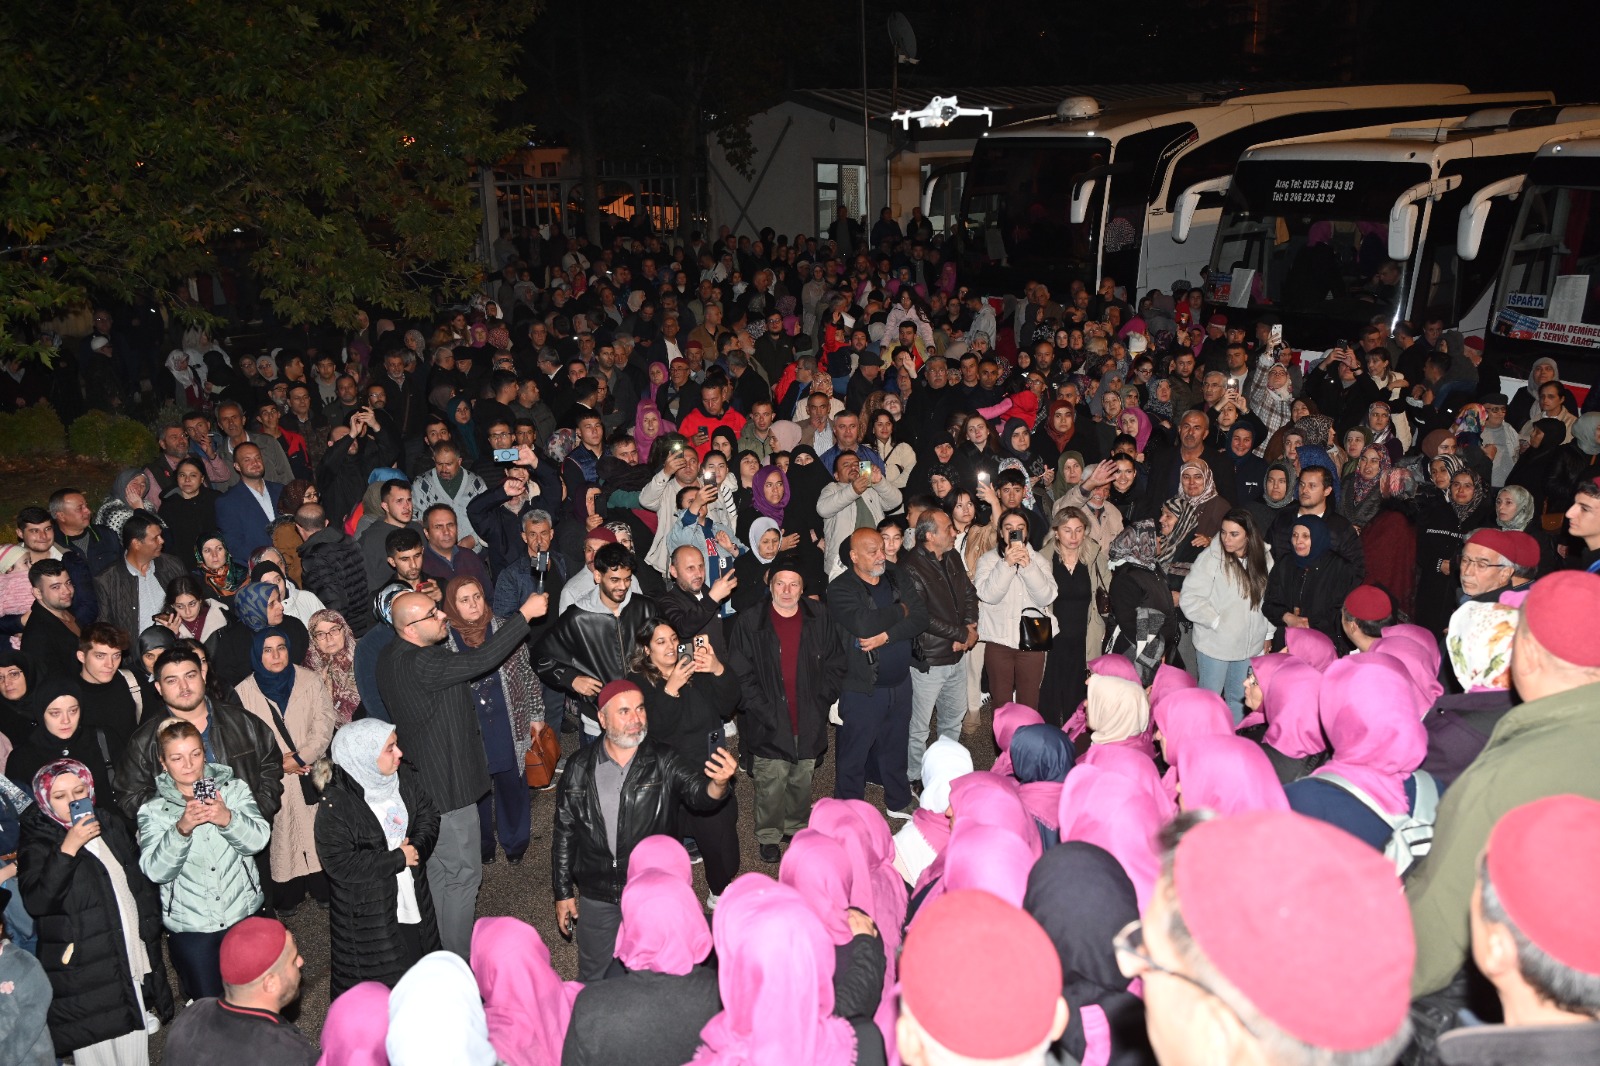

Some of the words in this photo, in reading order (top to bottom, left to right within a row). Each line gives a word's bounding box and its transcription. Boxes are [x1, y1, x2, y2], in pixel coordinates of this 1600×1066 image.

[1290, 179, 1302, 189] Tel:
[1272, 192, 1283, 201] Tel:
[1508, 294, 1544, 307] ISPARTA
[1538, 321, 1567, 332] EYMAN
